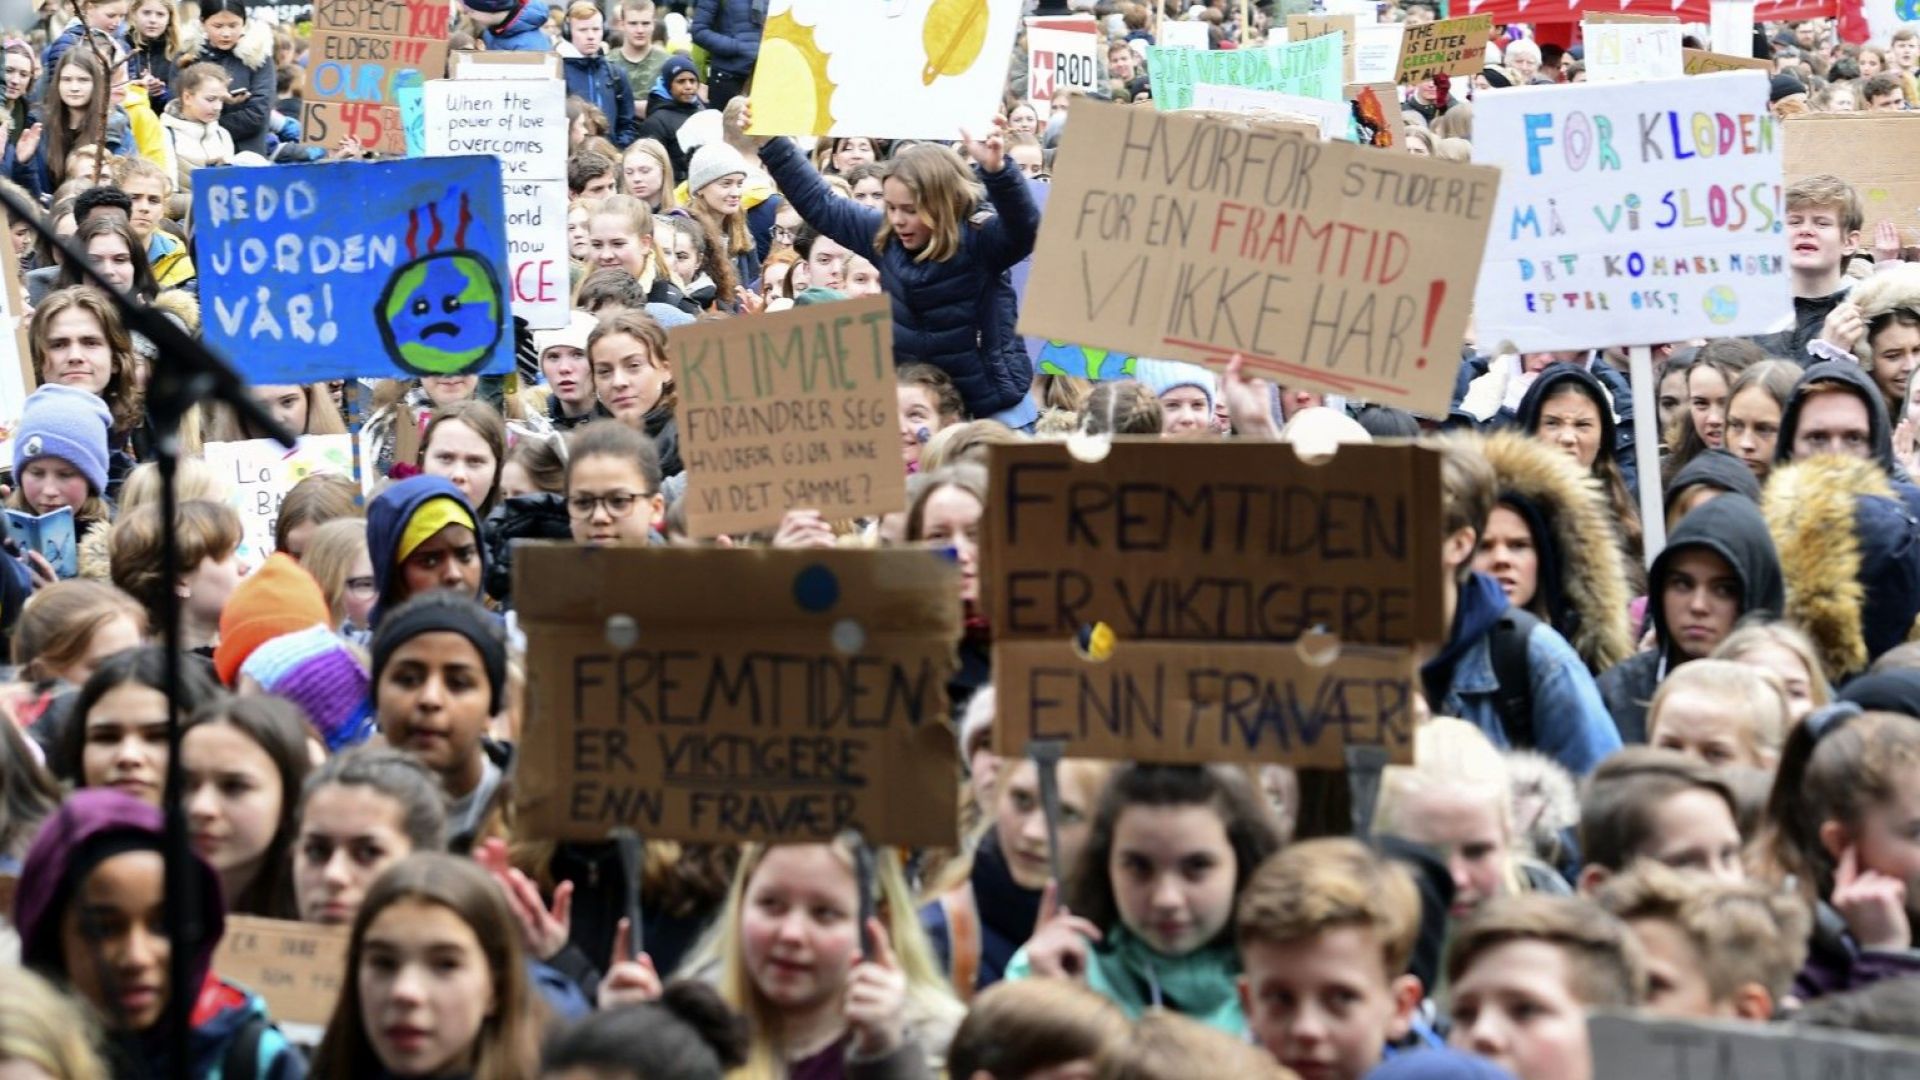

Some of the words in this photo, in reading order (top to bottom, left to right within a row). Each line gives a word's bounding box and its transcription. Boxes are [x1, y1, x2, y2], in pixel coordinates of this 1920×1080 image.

[1406, 24, 1435, 41] THE
[1407, 42, 1419, 54] IS
[1424, 35, 1466, 51] EITER
[314, 61, 385, 101] OUR
[1056, 53, 1092, 87] RØD
[1397, 69, 1419, 85] AT
[1403, 52, 1445, 69] GREEN
[447, 94, 493, 111] When
[504, 93, 531, 110] the
[303, 103, 327, 143] IS
[340, 103, 382, 147] 45
[448, 117, 493, 134] power
[499, 115, 514, 130] of
[519, 115, 545, 127] love
[1523, 110, 1621, 175] FOR
[1638, 110, 1774, 163] KLODEN
[448, 138, 544, 154] overcomes
[1116, 110, 1321, 211] HVORFOR
[1340, 161, 1489, 221] STUDERE
[208, 180, 317, 228] REDD
[507, 206, 541, 226] orld
[1510, 198, 1566, 240] MÅ
[1655, 182, 1782, 234] SLOSS!
[211, 233, 397, 275] JORDEN
[507, 240, 545, 253] now
[1075, 189, 1137, 242] FOR
[1145, 194, 1197, 248] EN
[1209, 201, 1411, 285] FRAMTID
[510, 260, 557, 302] CE
[1517, 254, 1578, 281] DET
[1604, 252, 1720, 278] KOMMER
[214, 283, 338, 346] VÅR!
[1081, 250, 1149, 327] VI
[1165, 262, 1291, 356] IKKE
[1301, 279, 1447, 379] HAR!
[1524, 291, 1609, 313] ETTER
[678, 310, 890, 403] KLIMAET
[687, 400, 835, 443] FORANDRER
[842, 398, 886, 430] SEG
[690, 447, 776, 475] HVORFOR
[782, 441, 832, 466] GJØR
[701, 486, 721, 513] VI
[729, 481, 772, 512] DET
[1005, 460, 1408, 561] FREMTIDEN
[1005, 569, 1094, 633] ER
[1113, 576, 1412, 645] VIKTIGERE
[573, 650, 932, 731] FREMTIDEN
[1028, 662, 1166, 741] ENN
[574, 729, 637, 774] ER
[657, 732, 870, 786] VIKTIGERE
[570, 780, 664, 826] ENN
[689, 789, 866, 836] FRAVÆR
